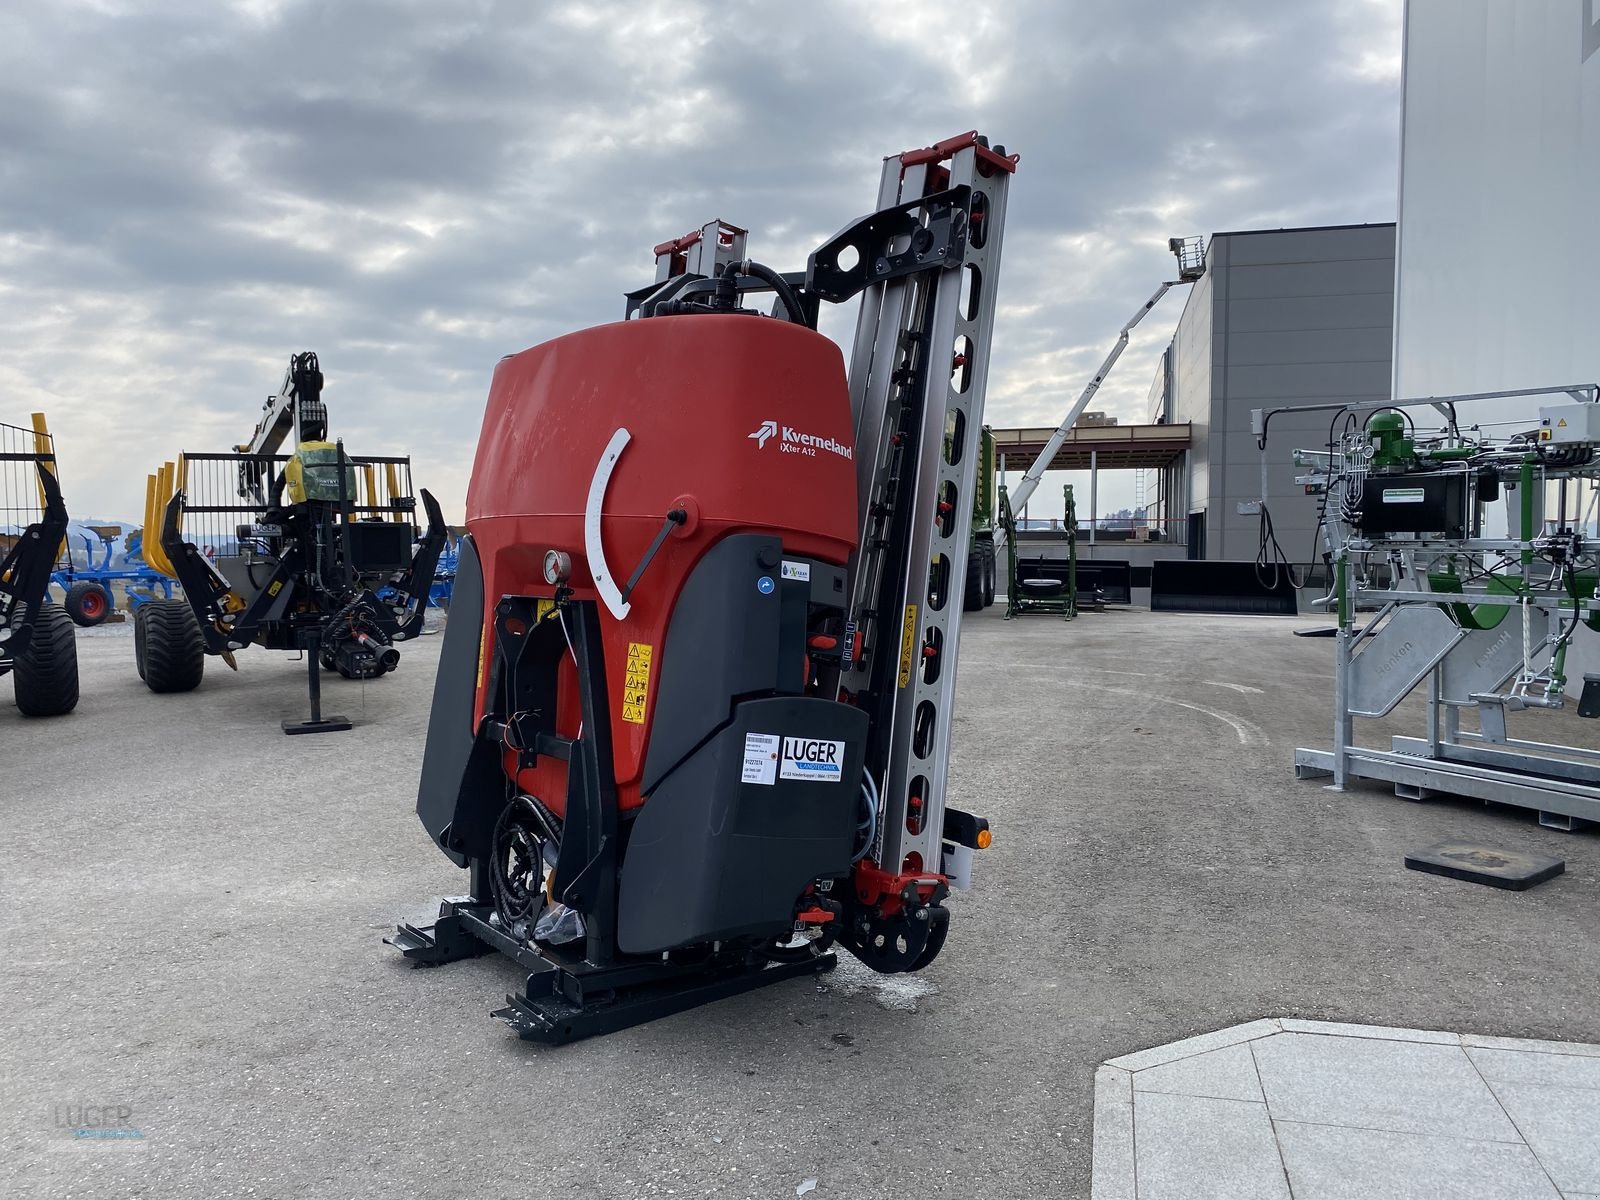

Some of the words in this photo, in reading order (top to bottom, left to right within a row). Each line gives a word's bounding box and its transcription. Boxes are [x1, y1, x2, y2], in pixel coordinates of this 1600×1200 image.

[780, 443, 800, 453] iXter
[801, 448, 816, 457] A12
[782, 426, 853, 460] Kverneland
[783, 739, 836, 763] LUGER
